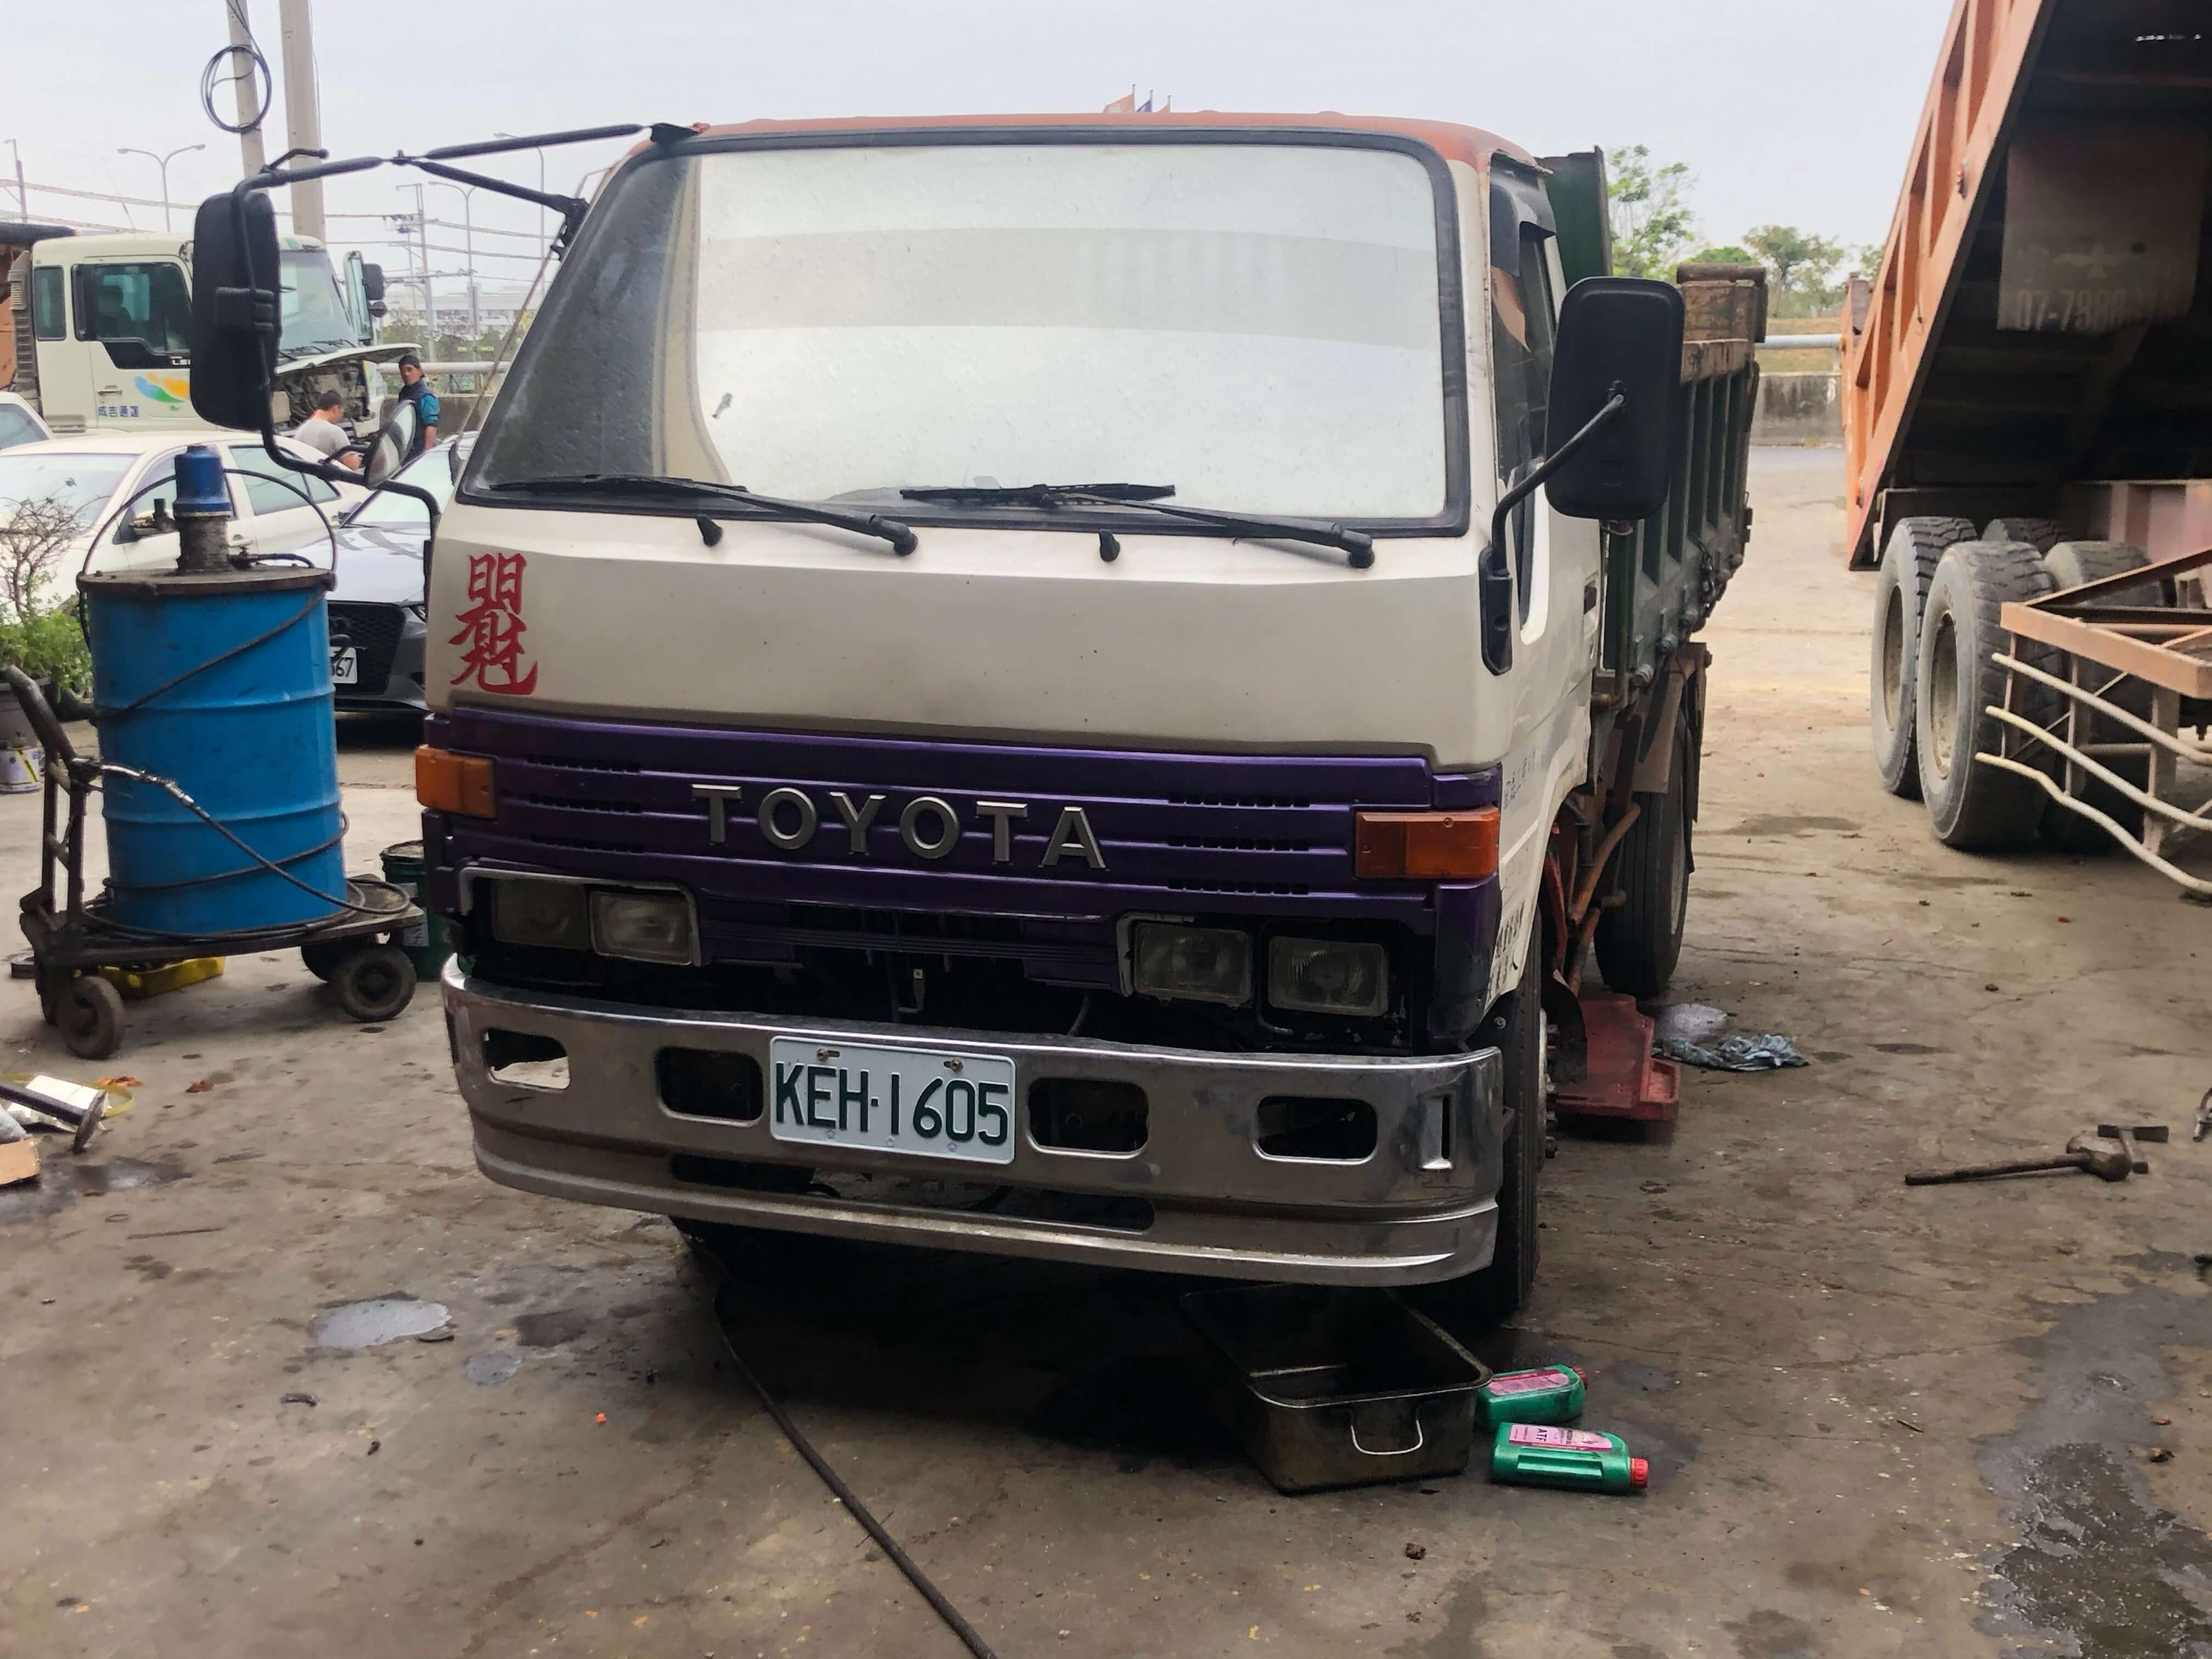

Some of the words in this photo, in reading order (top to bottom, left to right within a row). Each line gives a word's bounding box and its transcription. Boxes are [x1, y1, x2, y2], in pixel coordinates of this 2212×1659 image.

[691, 783, 1109, 870] TOYOTA
[775, 1061, 1009, 1146] KEH-1605
[1536, 1427, 1548, 1442] ATF
